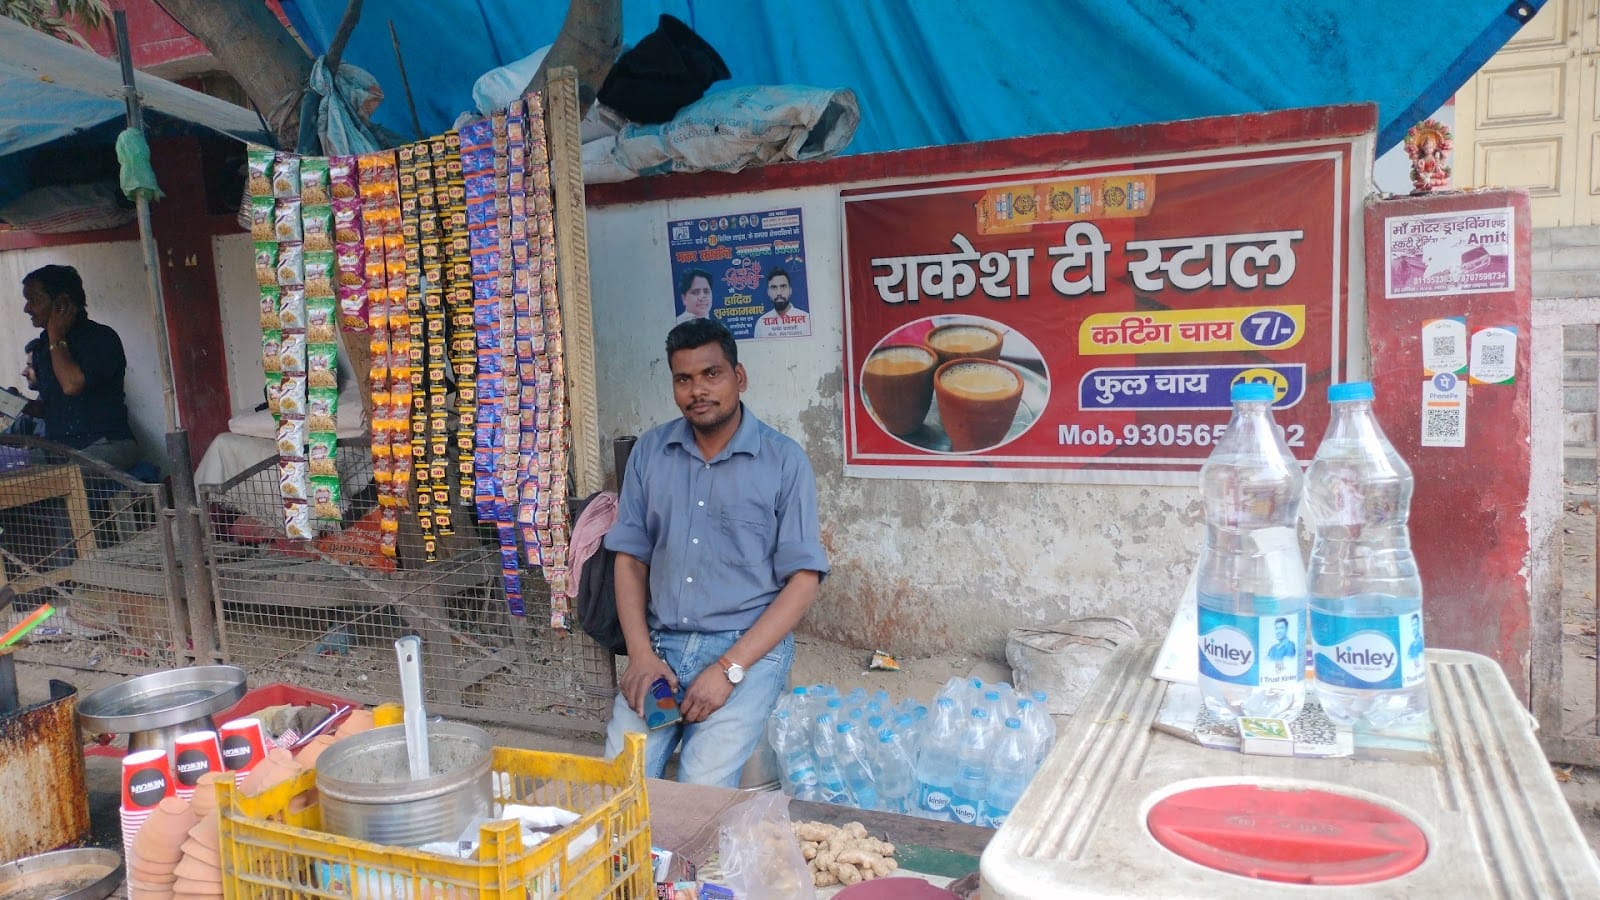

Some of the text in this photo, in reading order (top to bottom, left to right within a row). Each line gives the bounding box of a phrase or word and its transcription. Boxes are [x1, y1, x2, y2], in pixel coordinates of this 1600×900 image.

[1410, 220, 1441, 233] मोटर
[1443, 216, 1490, 235] ड्राइविंग
[1467, 230, 1506, 245] Amit
[871, 221, 1304, 304] राकेश टी स्टाल
[1091, 316, 1294, 346] कटिंग चाय 7/-
[1094, 373, 1148, 405] फुल
[1154, 373, 1209, 395] चाय
[1203, 637, 1252, 665] kinley
[1335, 646, 1395, 668] kinley
[955, 808, 975, 819] kinley
